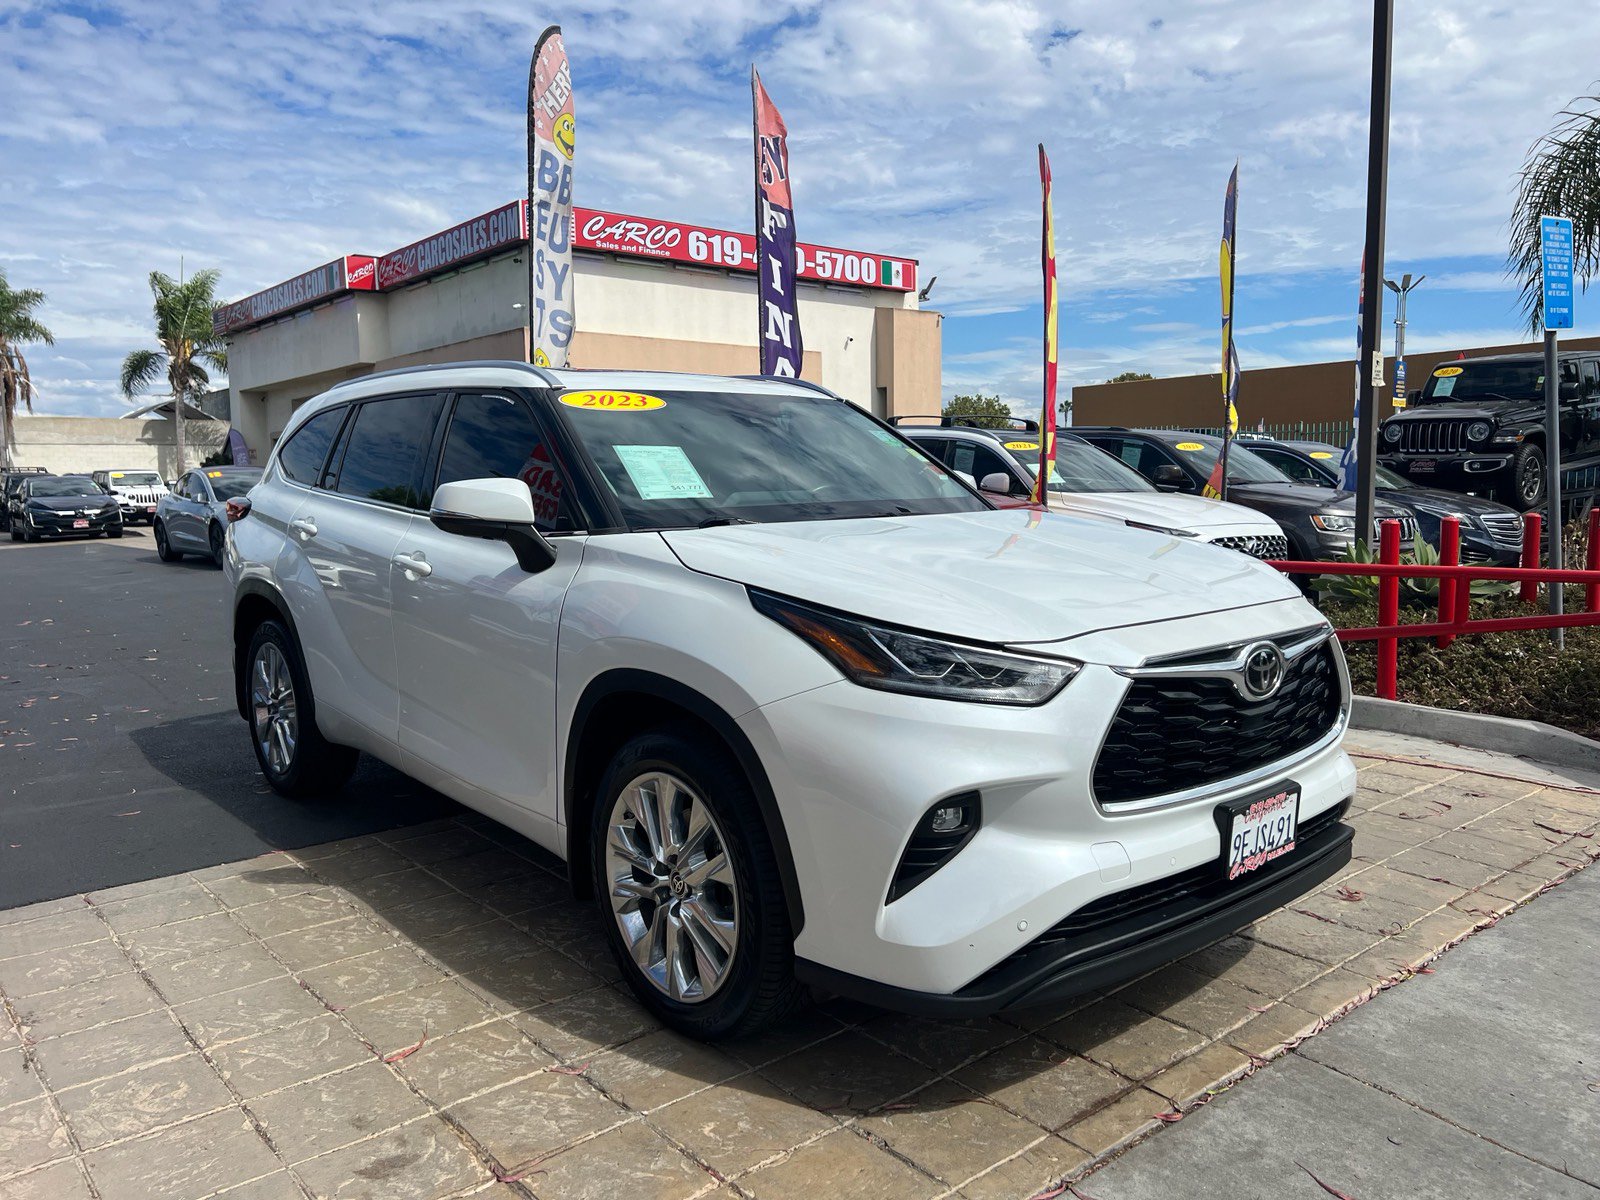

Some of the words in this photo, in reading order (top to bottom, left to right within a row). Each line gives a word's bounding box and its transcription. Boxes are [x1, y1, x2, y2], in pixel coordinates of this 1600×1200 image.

[417, 206, 519, 272] CARCOSALES.COM
[582, 216, 681, 249] CARCO
[595, 240, 620, 250] Sales
[621, 244, 637, 252] and
[638, 245, 671, 257] Finance
[347, 262, 374, 283] CARCO
[378, 247, 417, 283] CARCO
[251, 268, 327, 320] CARCOSALES.COM
[582, 394, 648, 407] 2023
[1232, 813, 1292, 867] 9EJS491
